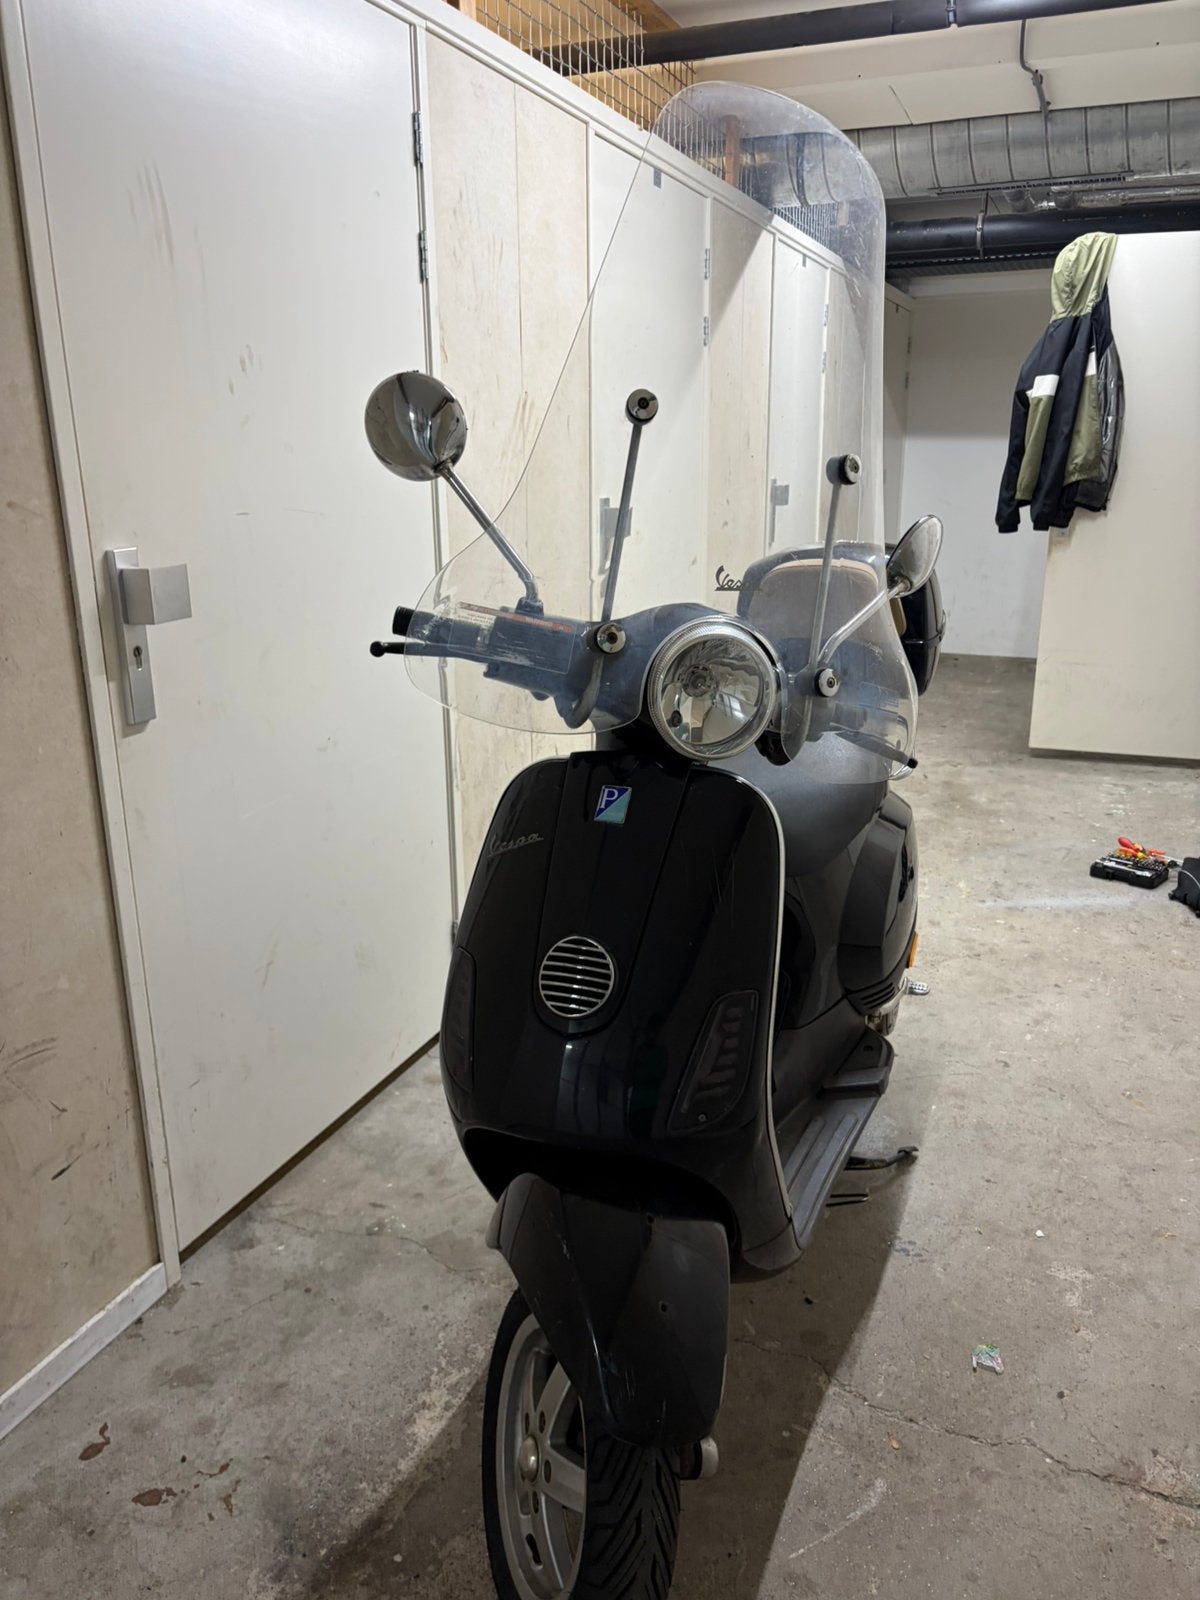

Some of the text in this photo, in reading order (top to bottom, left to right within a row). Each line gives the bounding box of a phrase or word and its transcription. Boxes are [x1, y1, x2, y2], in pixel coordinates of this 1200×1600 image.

[714, 565, 763, 591] Ves
[601, 788, 618, 808] P
[488, 832, 544, 857] Vespa
